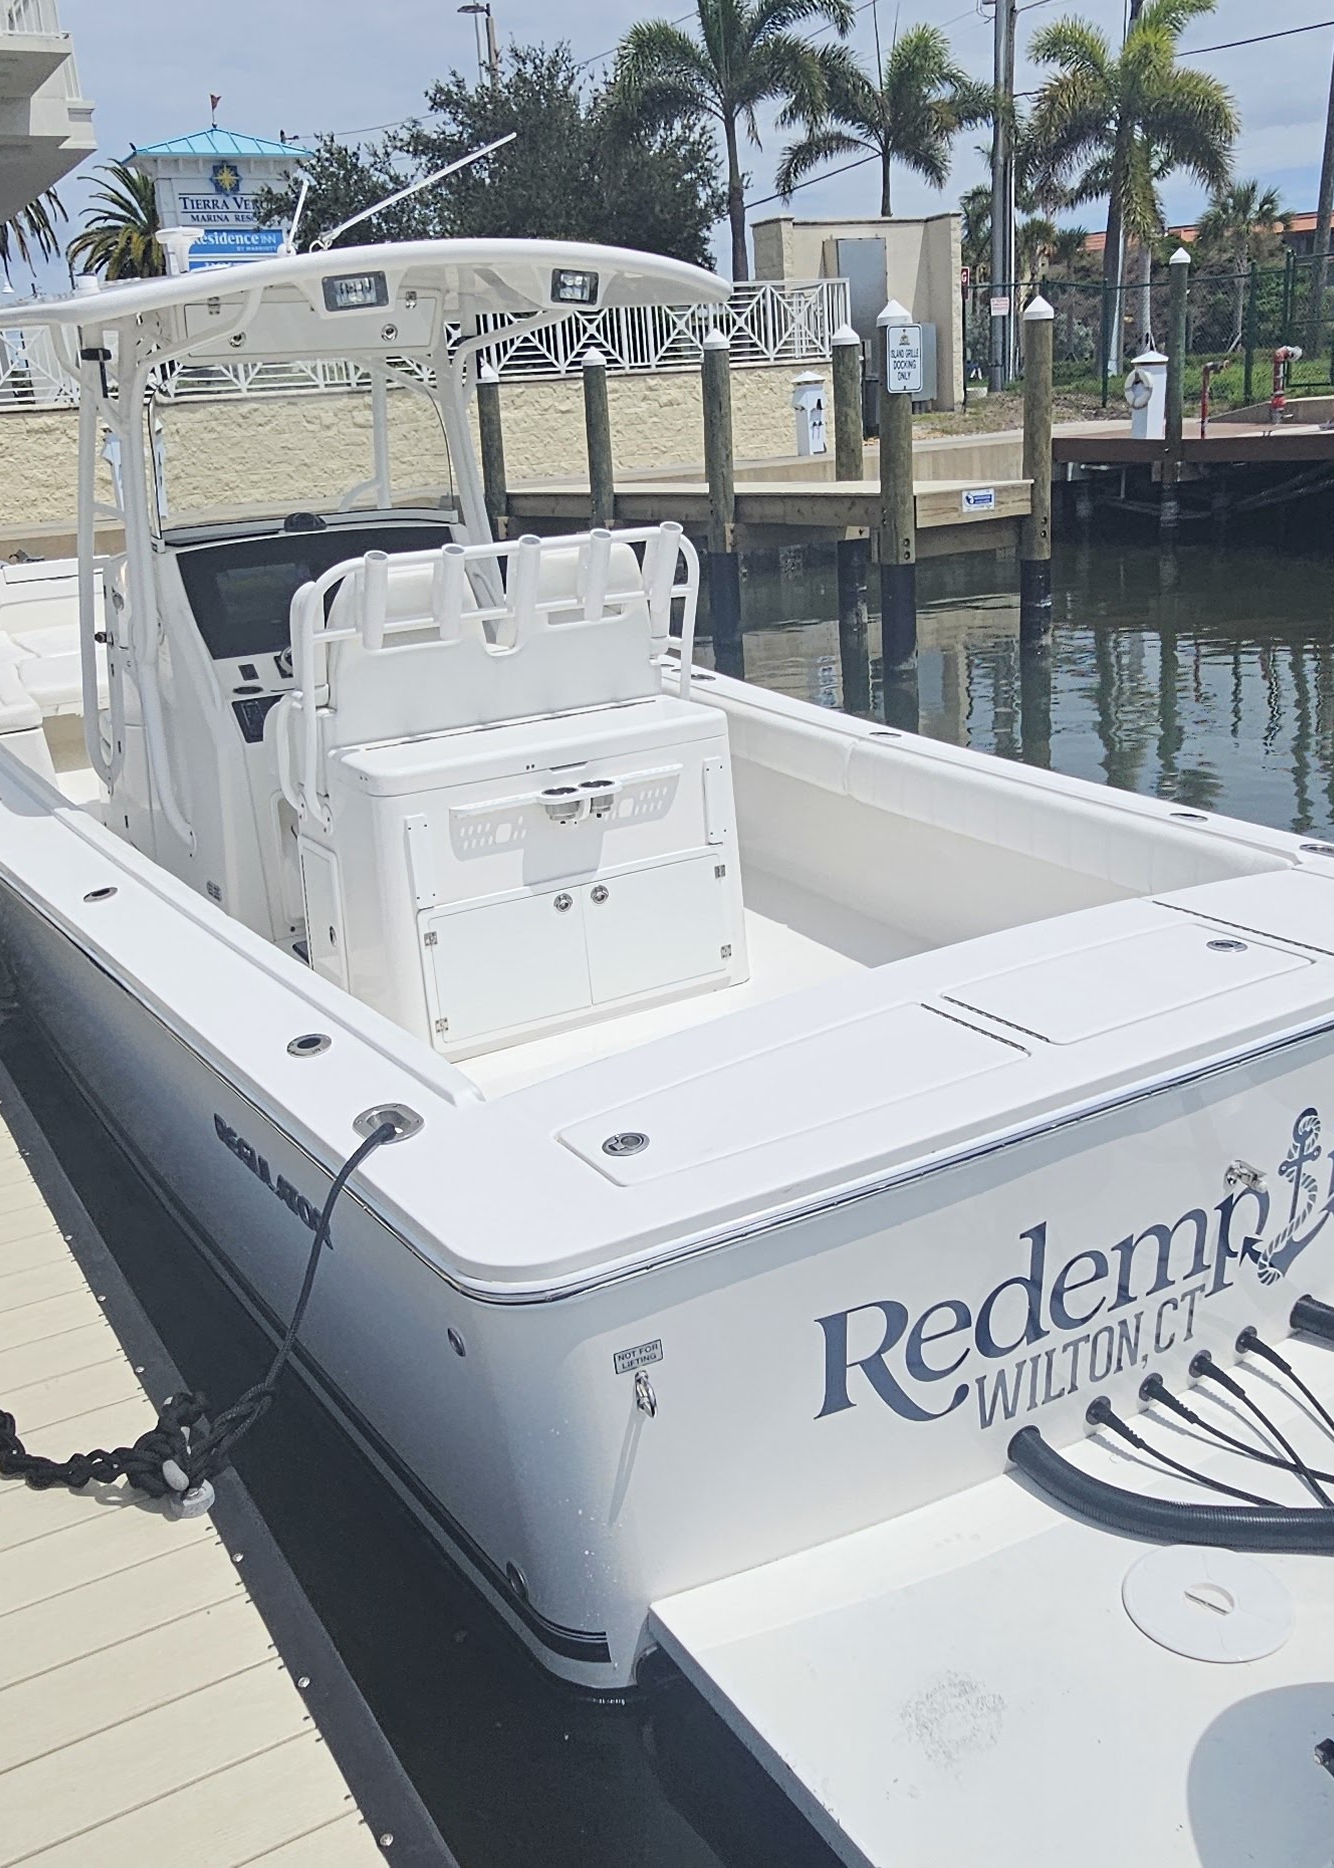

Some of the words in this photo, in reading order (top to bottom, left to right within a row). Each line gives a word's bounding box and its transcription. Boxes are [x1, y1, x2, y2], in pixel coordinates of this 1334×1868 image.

[179, 197, 229, 210] TIERRA
[190, 214, 229, 223] MARINA
[261, 234, 277, 244] INN
[893, 360, 917, 370] DOCKING
[897, 371, 911, 380] ONLY
[618, 1350, 636, 1361] NOT
[639, 1344, 658, 1354] FOR
[622, 1353, 656, 1369] LIFTING
